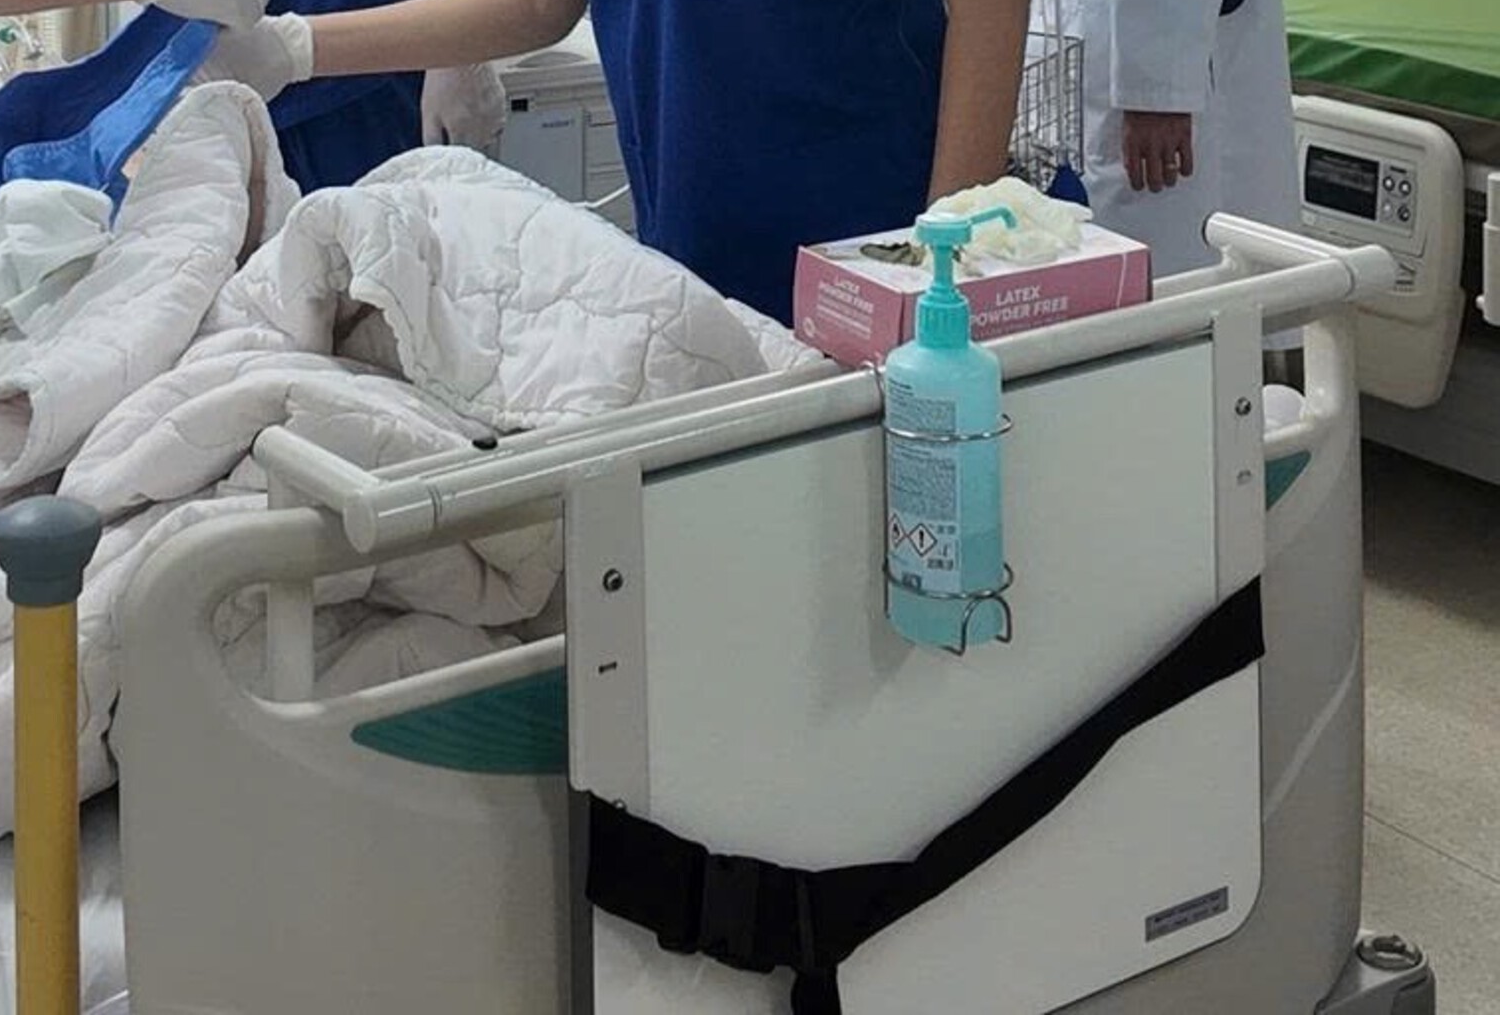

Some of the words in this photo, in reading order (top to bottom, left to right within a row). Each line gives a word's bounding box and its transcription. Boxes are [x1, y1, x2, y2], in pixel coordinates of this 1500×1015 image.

[996, 285, 1041, 306] LATEX
[969, 303, 1030, 327] POWDER
[1034, 296, 1068, 317] FREE
